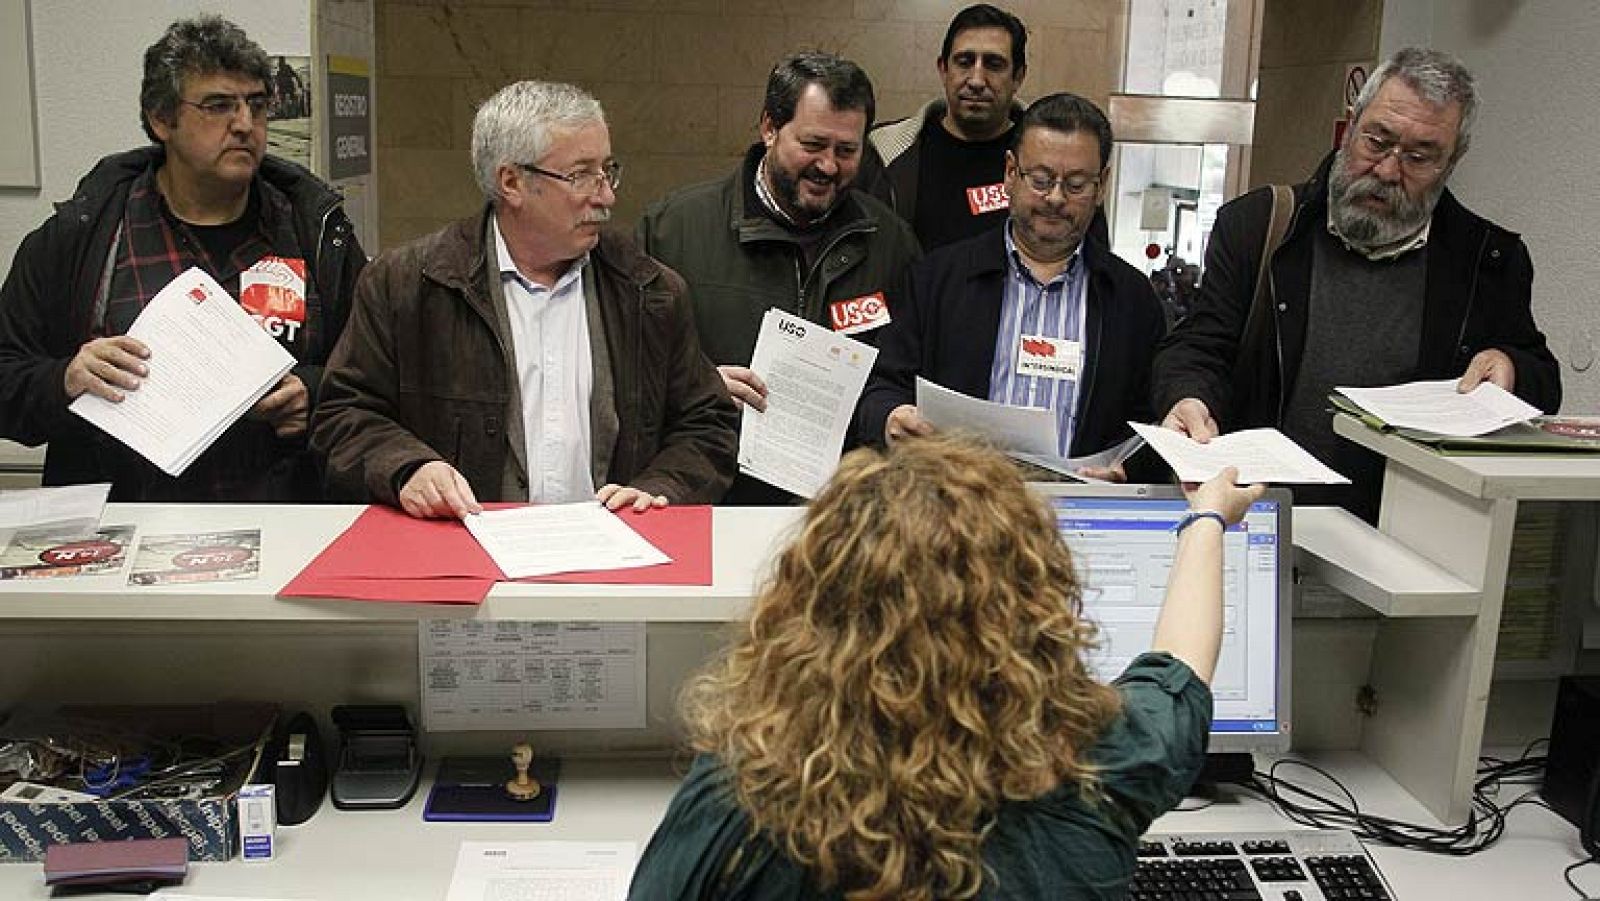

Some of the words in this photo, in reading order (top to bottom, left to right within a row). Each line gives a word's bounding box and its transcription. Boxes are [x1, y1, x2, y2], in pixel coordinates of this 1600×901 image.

[335, 94, 367, 117] REGISTRO
[336, 135, 367, 160] GENERAL
[831, 298, 881, 327] USO
[254, 316, 301, 341] GT
[779, 318, 806, 339] USO
